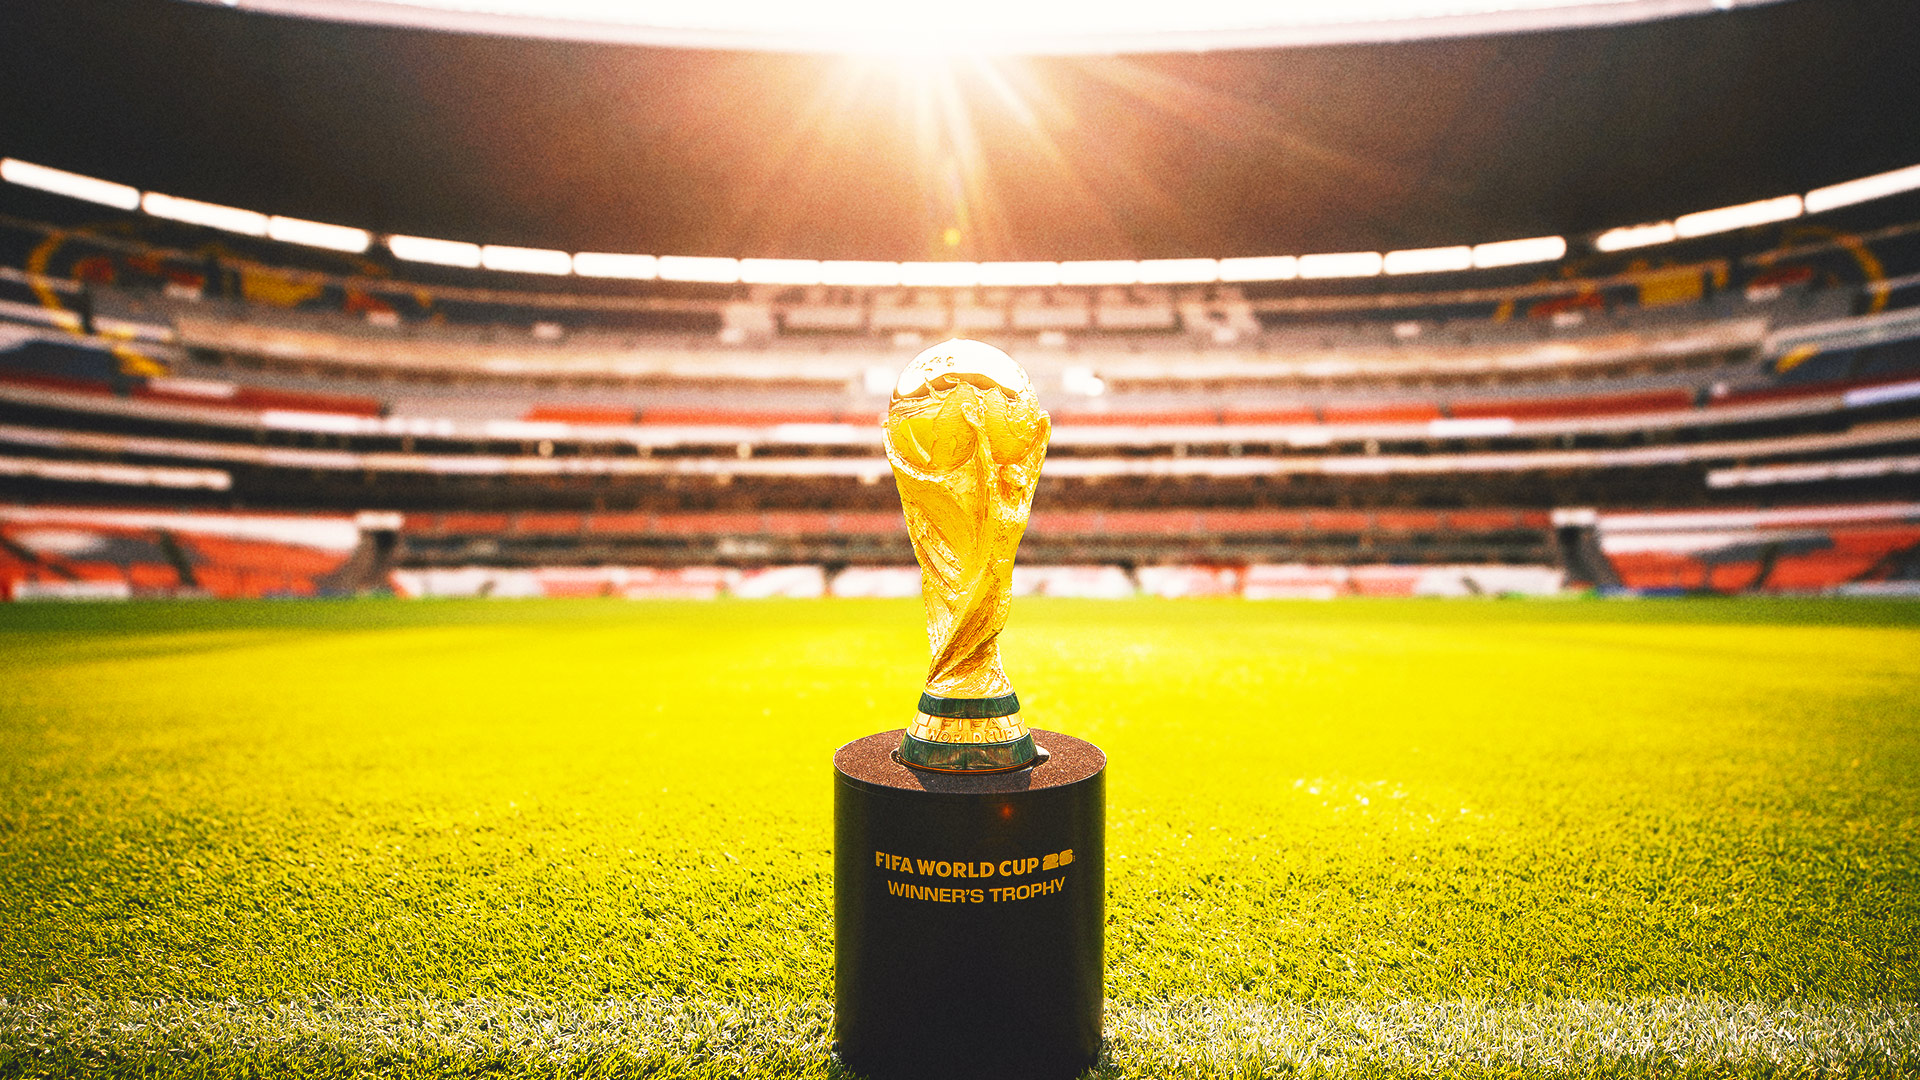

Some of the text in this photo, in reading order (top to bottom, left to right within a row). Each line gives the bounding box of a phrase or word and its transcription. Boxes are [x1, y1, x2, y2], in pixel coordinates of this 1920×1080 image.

[941, 717, 1002, 731] FIFA
[928, 727, 1015, 743] WORLD CUP
[875, 851, 914, 874] FIFA
[917, 859, 995, 878] WORLD
[999, 857, 1039, 877] CUP
[888, 876, 1066, 903] WINNER'S TROPHY
